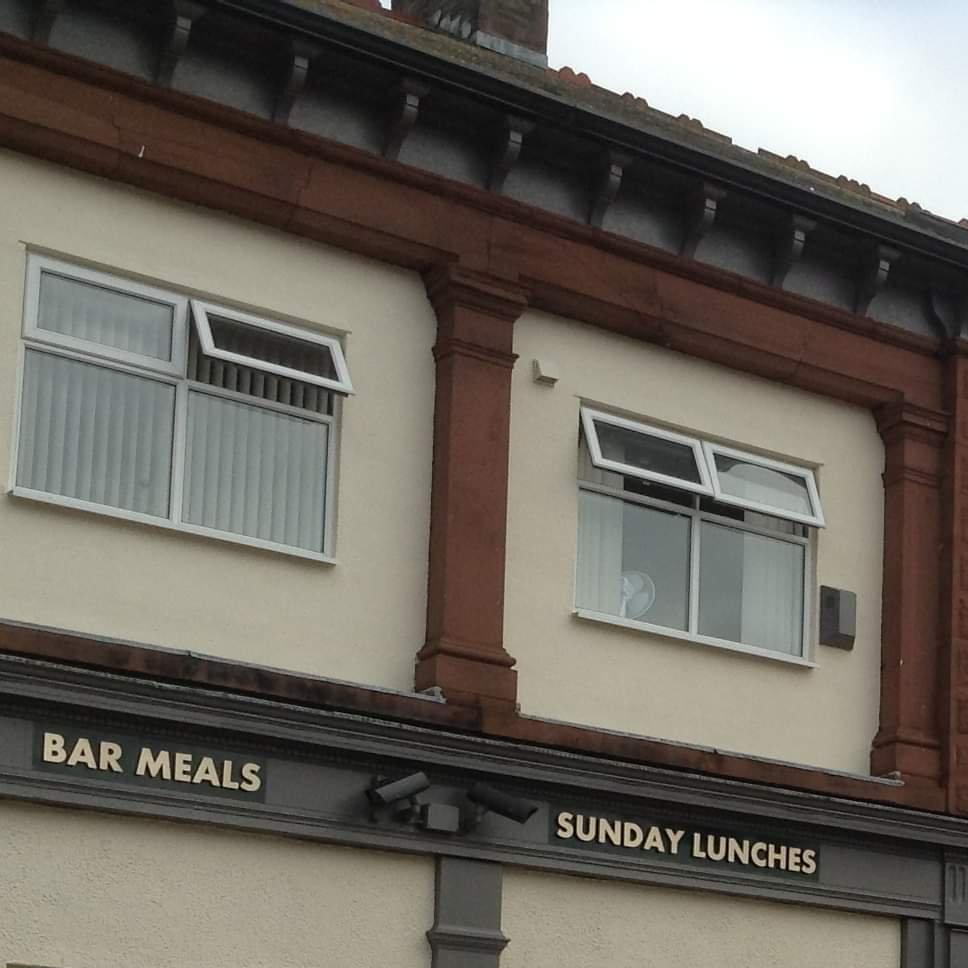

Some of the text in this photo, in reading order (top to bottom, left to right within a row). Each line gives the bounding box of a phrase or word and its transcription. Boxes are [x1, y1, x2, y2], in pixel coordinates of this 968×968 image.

[42, 733, 262, 793] BAR MEALS
[556, 811, 817, 875] SUNDAY LUNCHES
